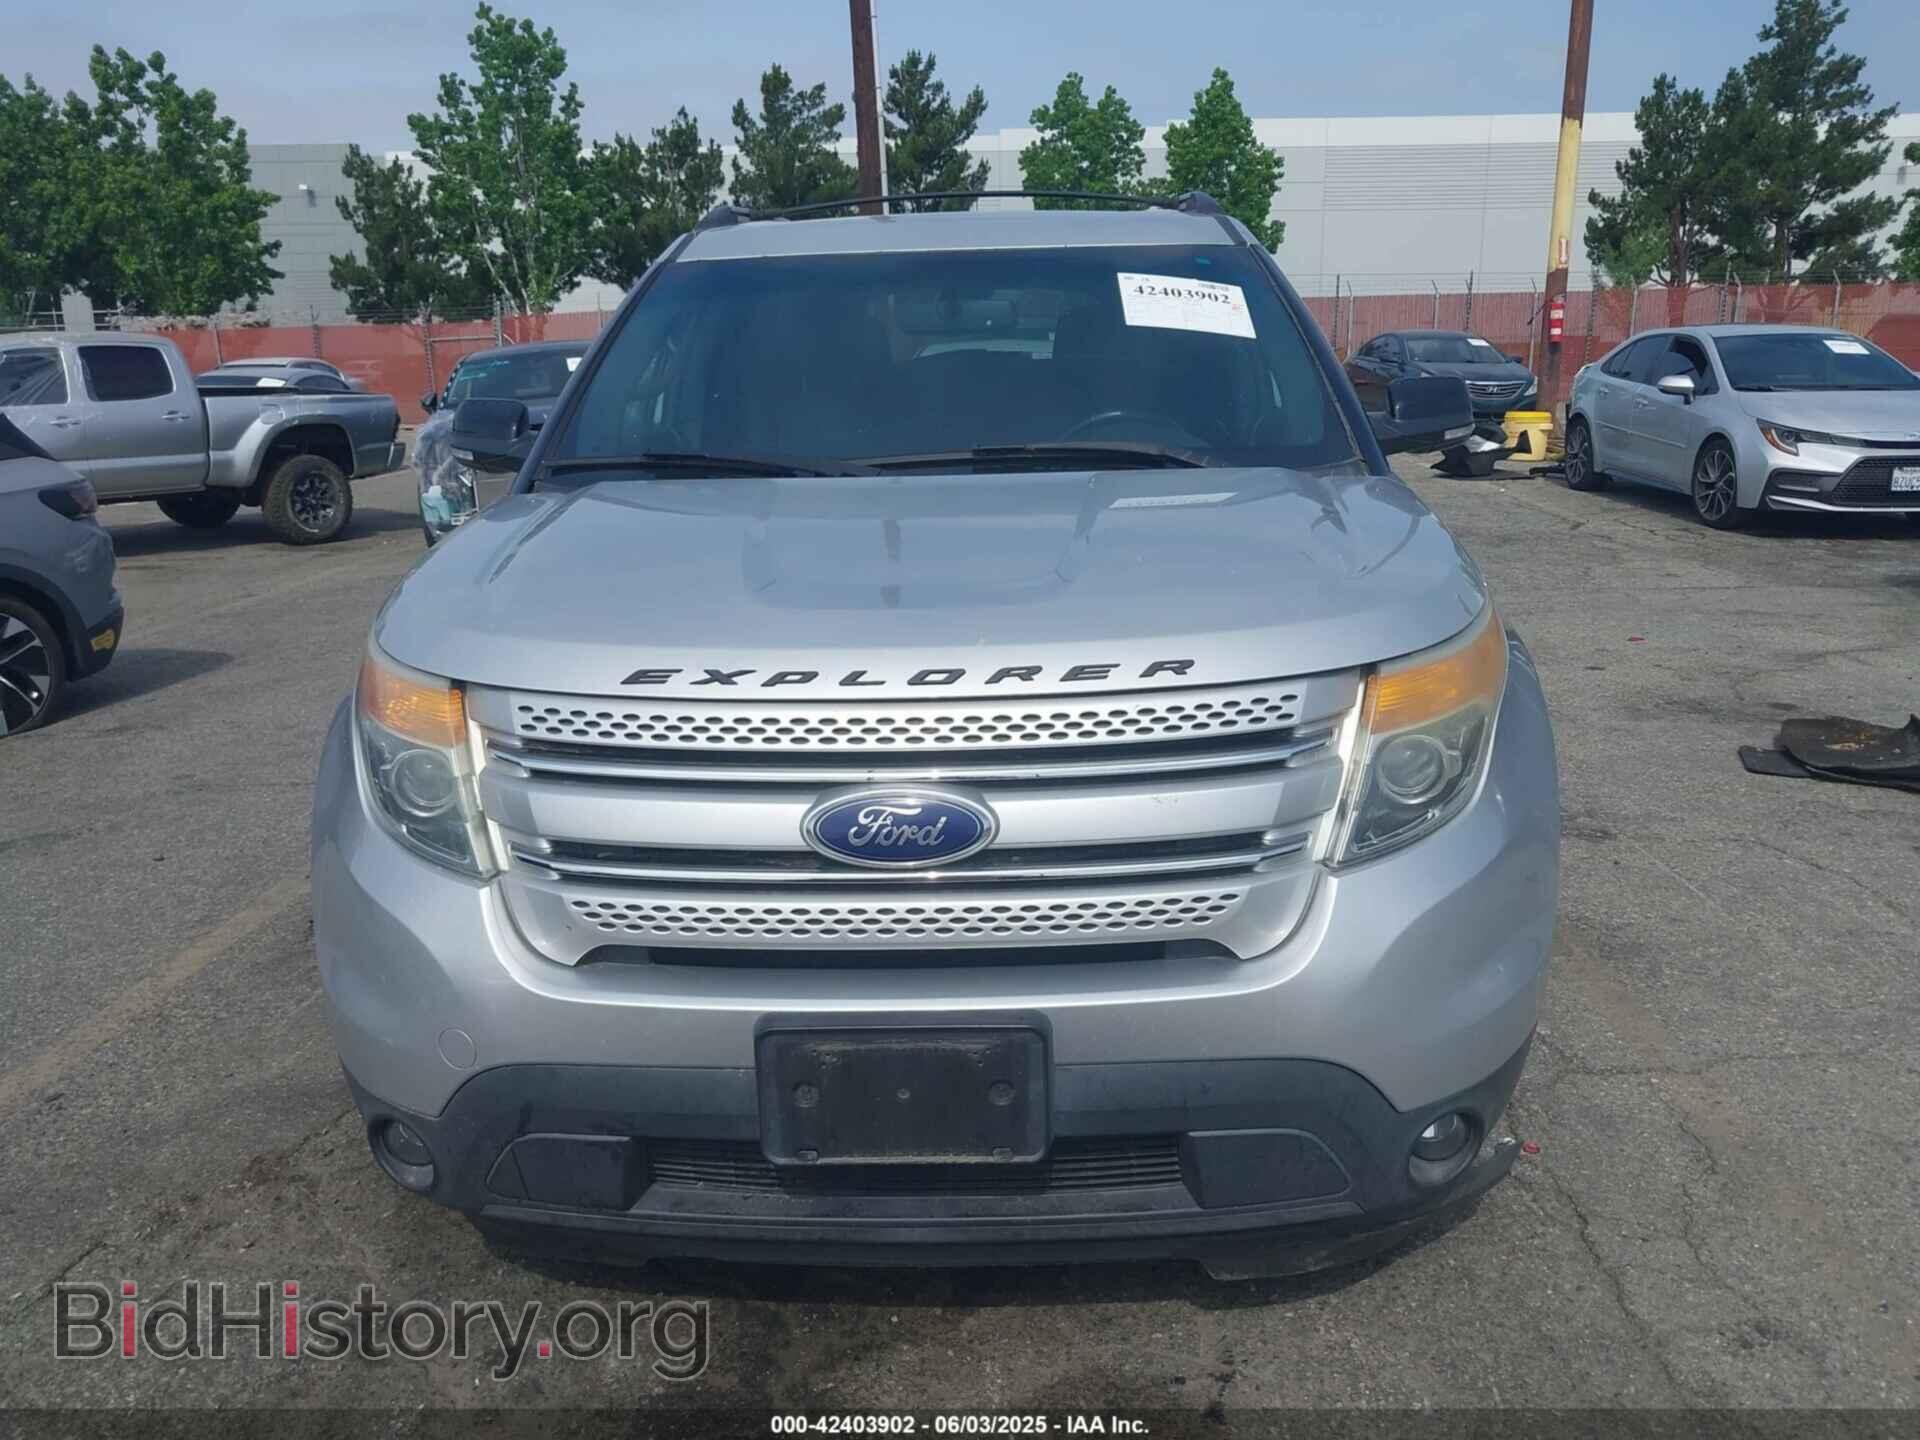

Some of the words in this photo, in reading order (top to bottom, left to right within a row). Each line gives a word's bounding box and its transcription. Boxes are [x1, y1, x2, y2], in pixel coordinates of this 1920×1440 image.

[1133, 285, 1231, 305] 42403902
[620, 659, 1196, 688] EXPLORER
[848, 805, 948, 847] Ford
